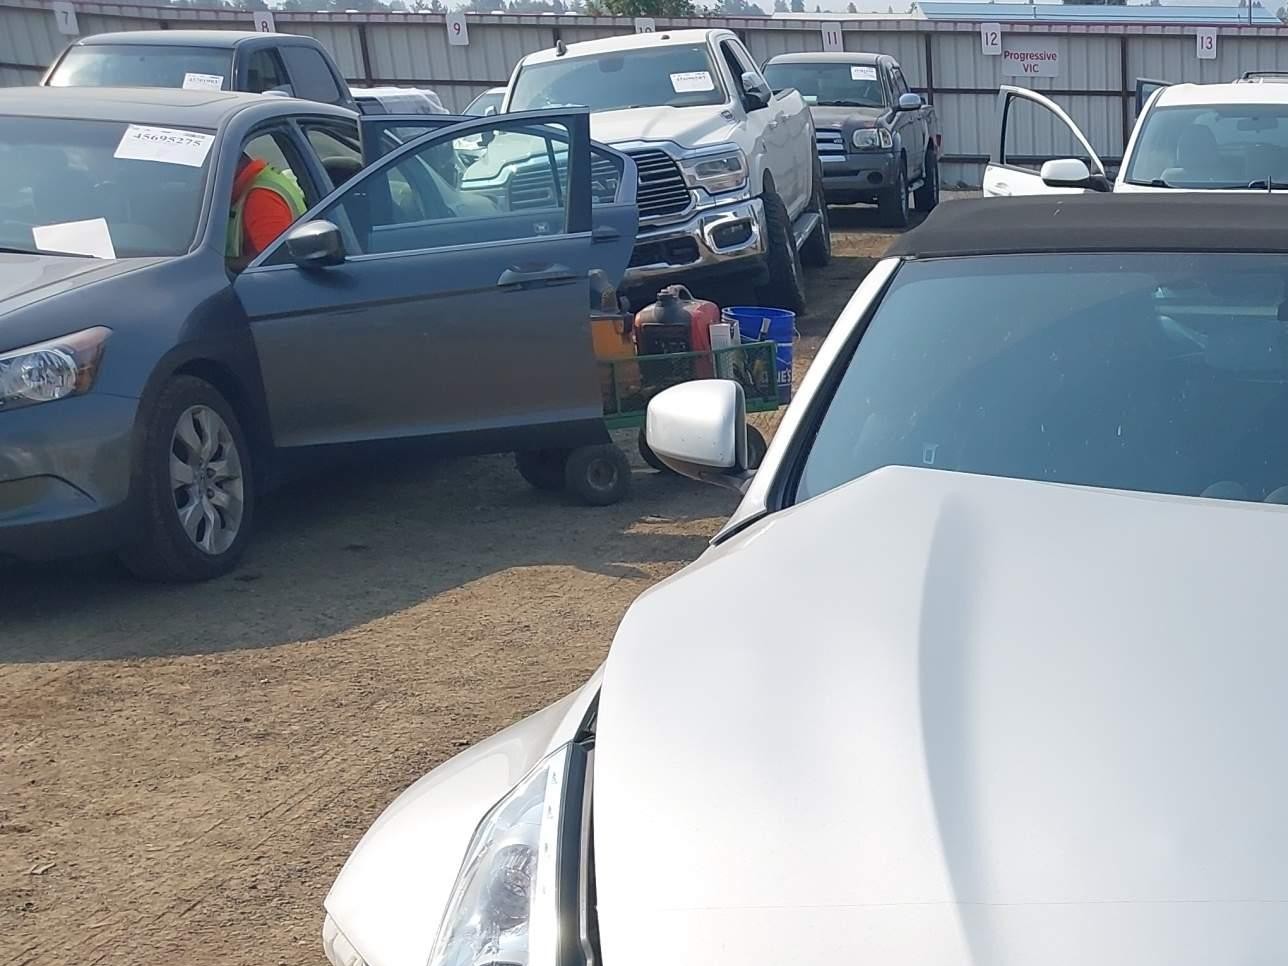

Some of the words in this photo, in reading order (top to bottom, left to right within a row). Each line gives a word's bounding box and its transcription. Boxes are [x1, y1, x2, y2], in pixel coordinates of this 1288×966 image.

[62, 11, 69, 25] 7
[261, 20, 269, 32] 8
[453, 22, 461, 36] 9
[827, 31, 838, 45] 11
[984, 32, 998, 46] 12
[1200, 36, 1213, 50] 13
[1003, 50, 1057, 62] Progressive
[1022, 63, 1039, 73] VIC
